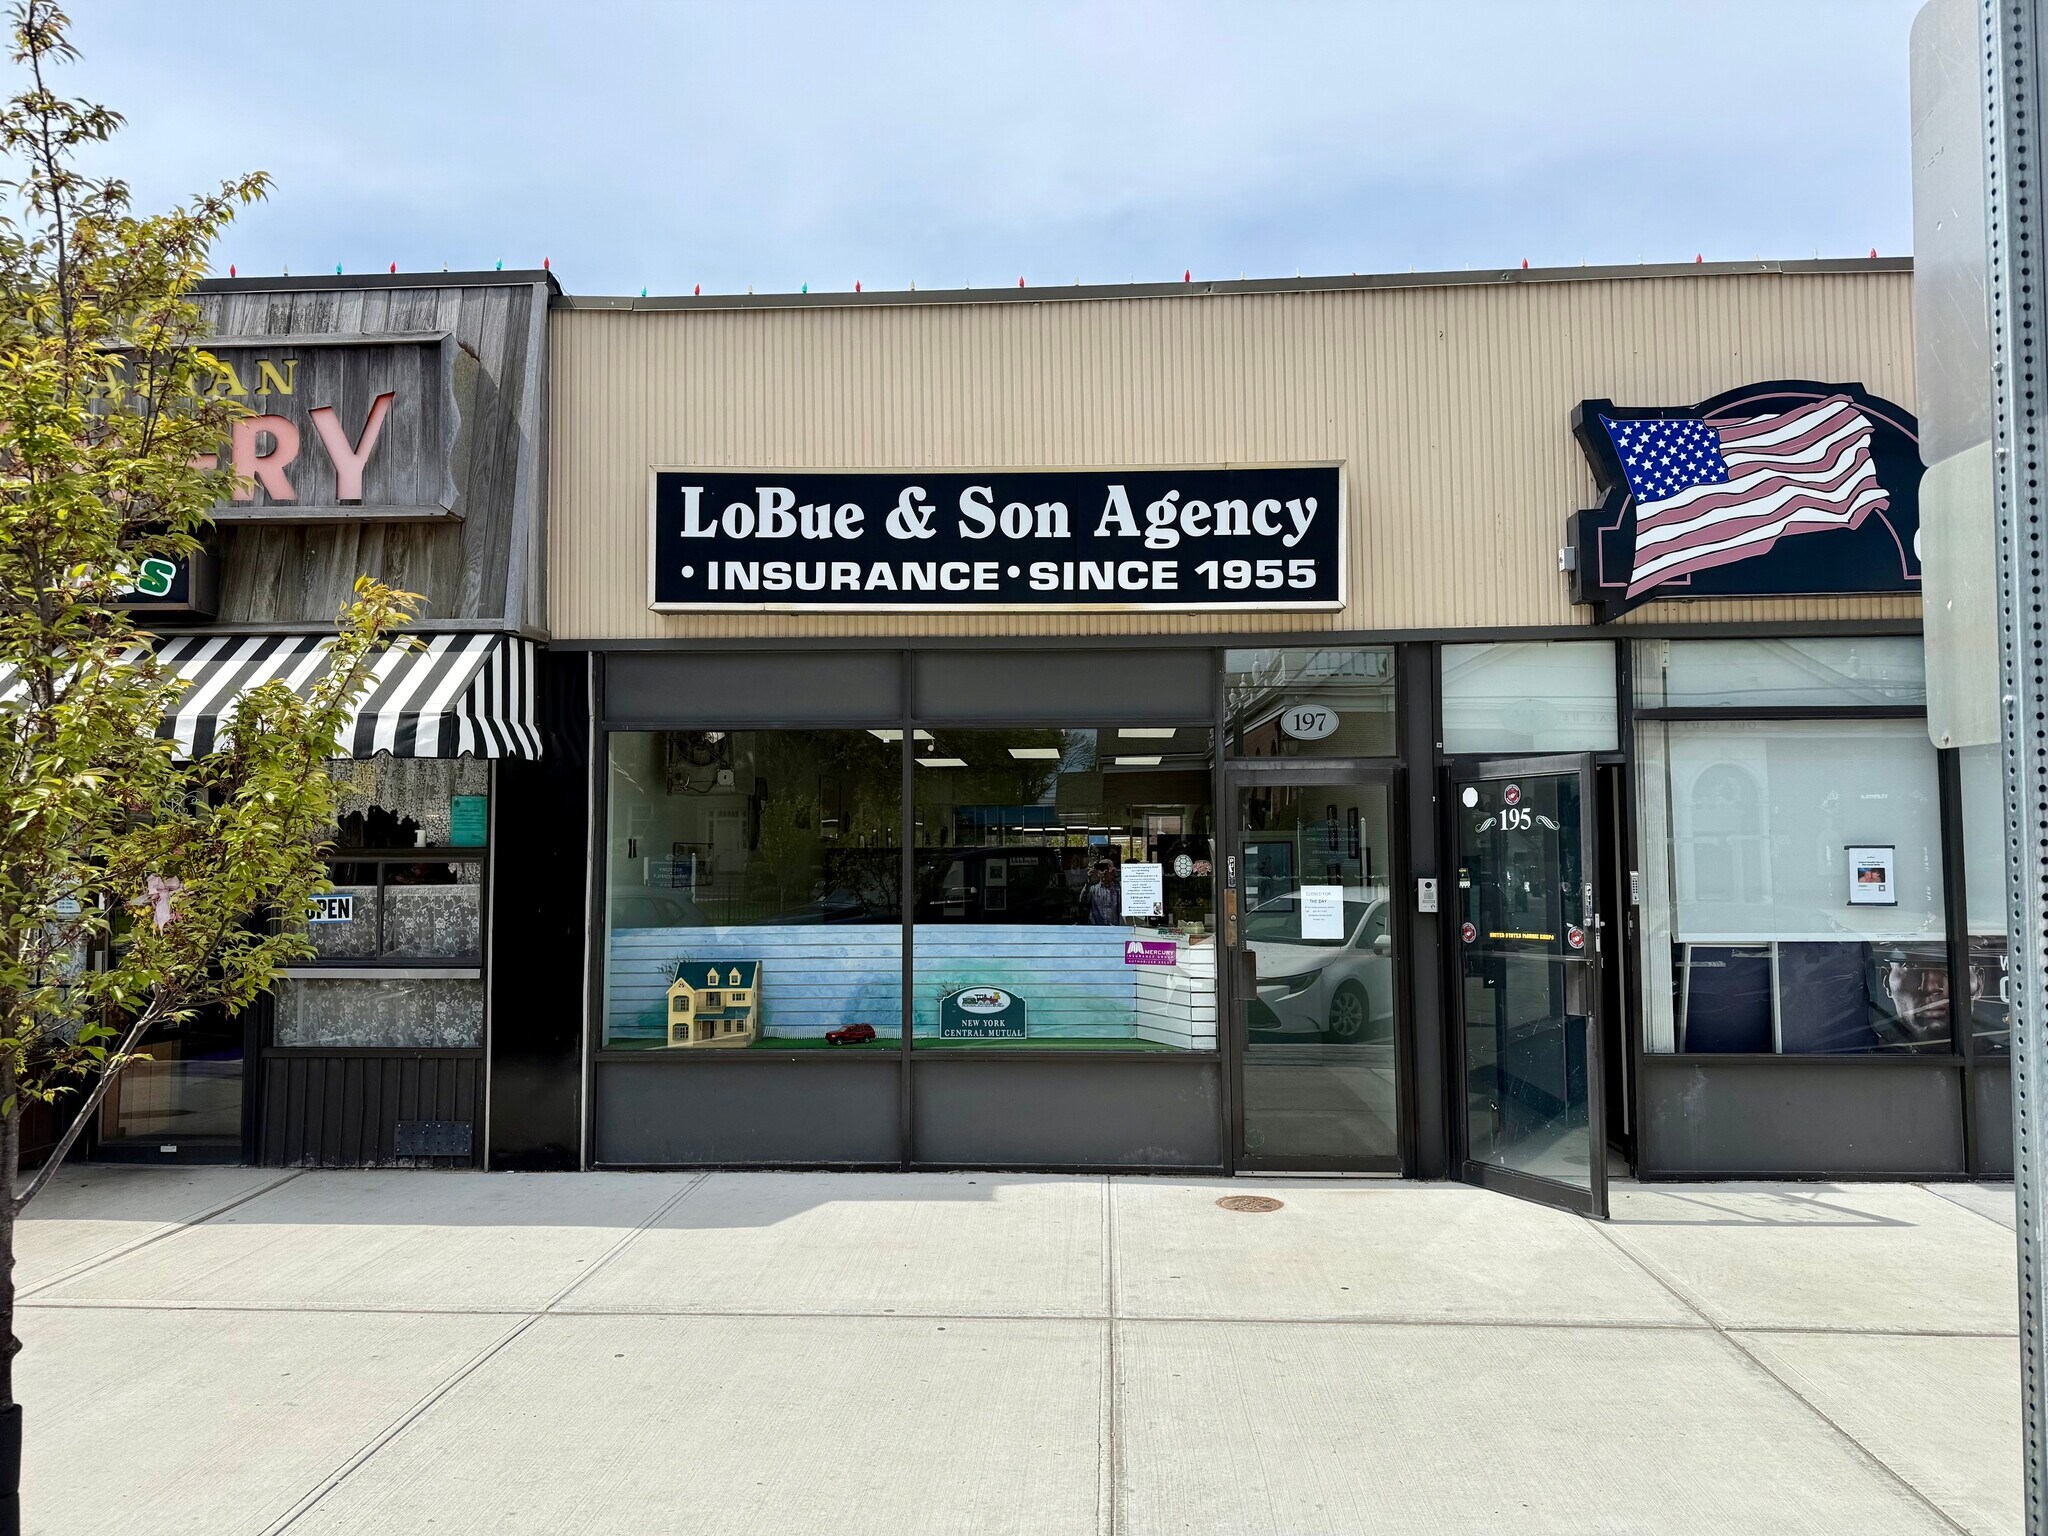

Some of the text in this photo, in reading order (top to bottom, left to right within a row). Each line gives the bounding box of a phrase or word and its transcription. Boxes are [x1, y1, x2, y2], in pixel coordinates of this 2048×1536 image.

[680, 484, 1319, 549] LoBue & Son Agency
[707, 558, 1317, 592] INSURANCE SINCE 1955
[1293, 712, 1328, 732] 197
[1499, 807, 1533, 831] 195
[944, 1029, 1023, 1037] CENTRAL MUTUAL
[961, 1019, 1006, 1027] NEW YORK
